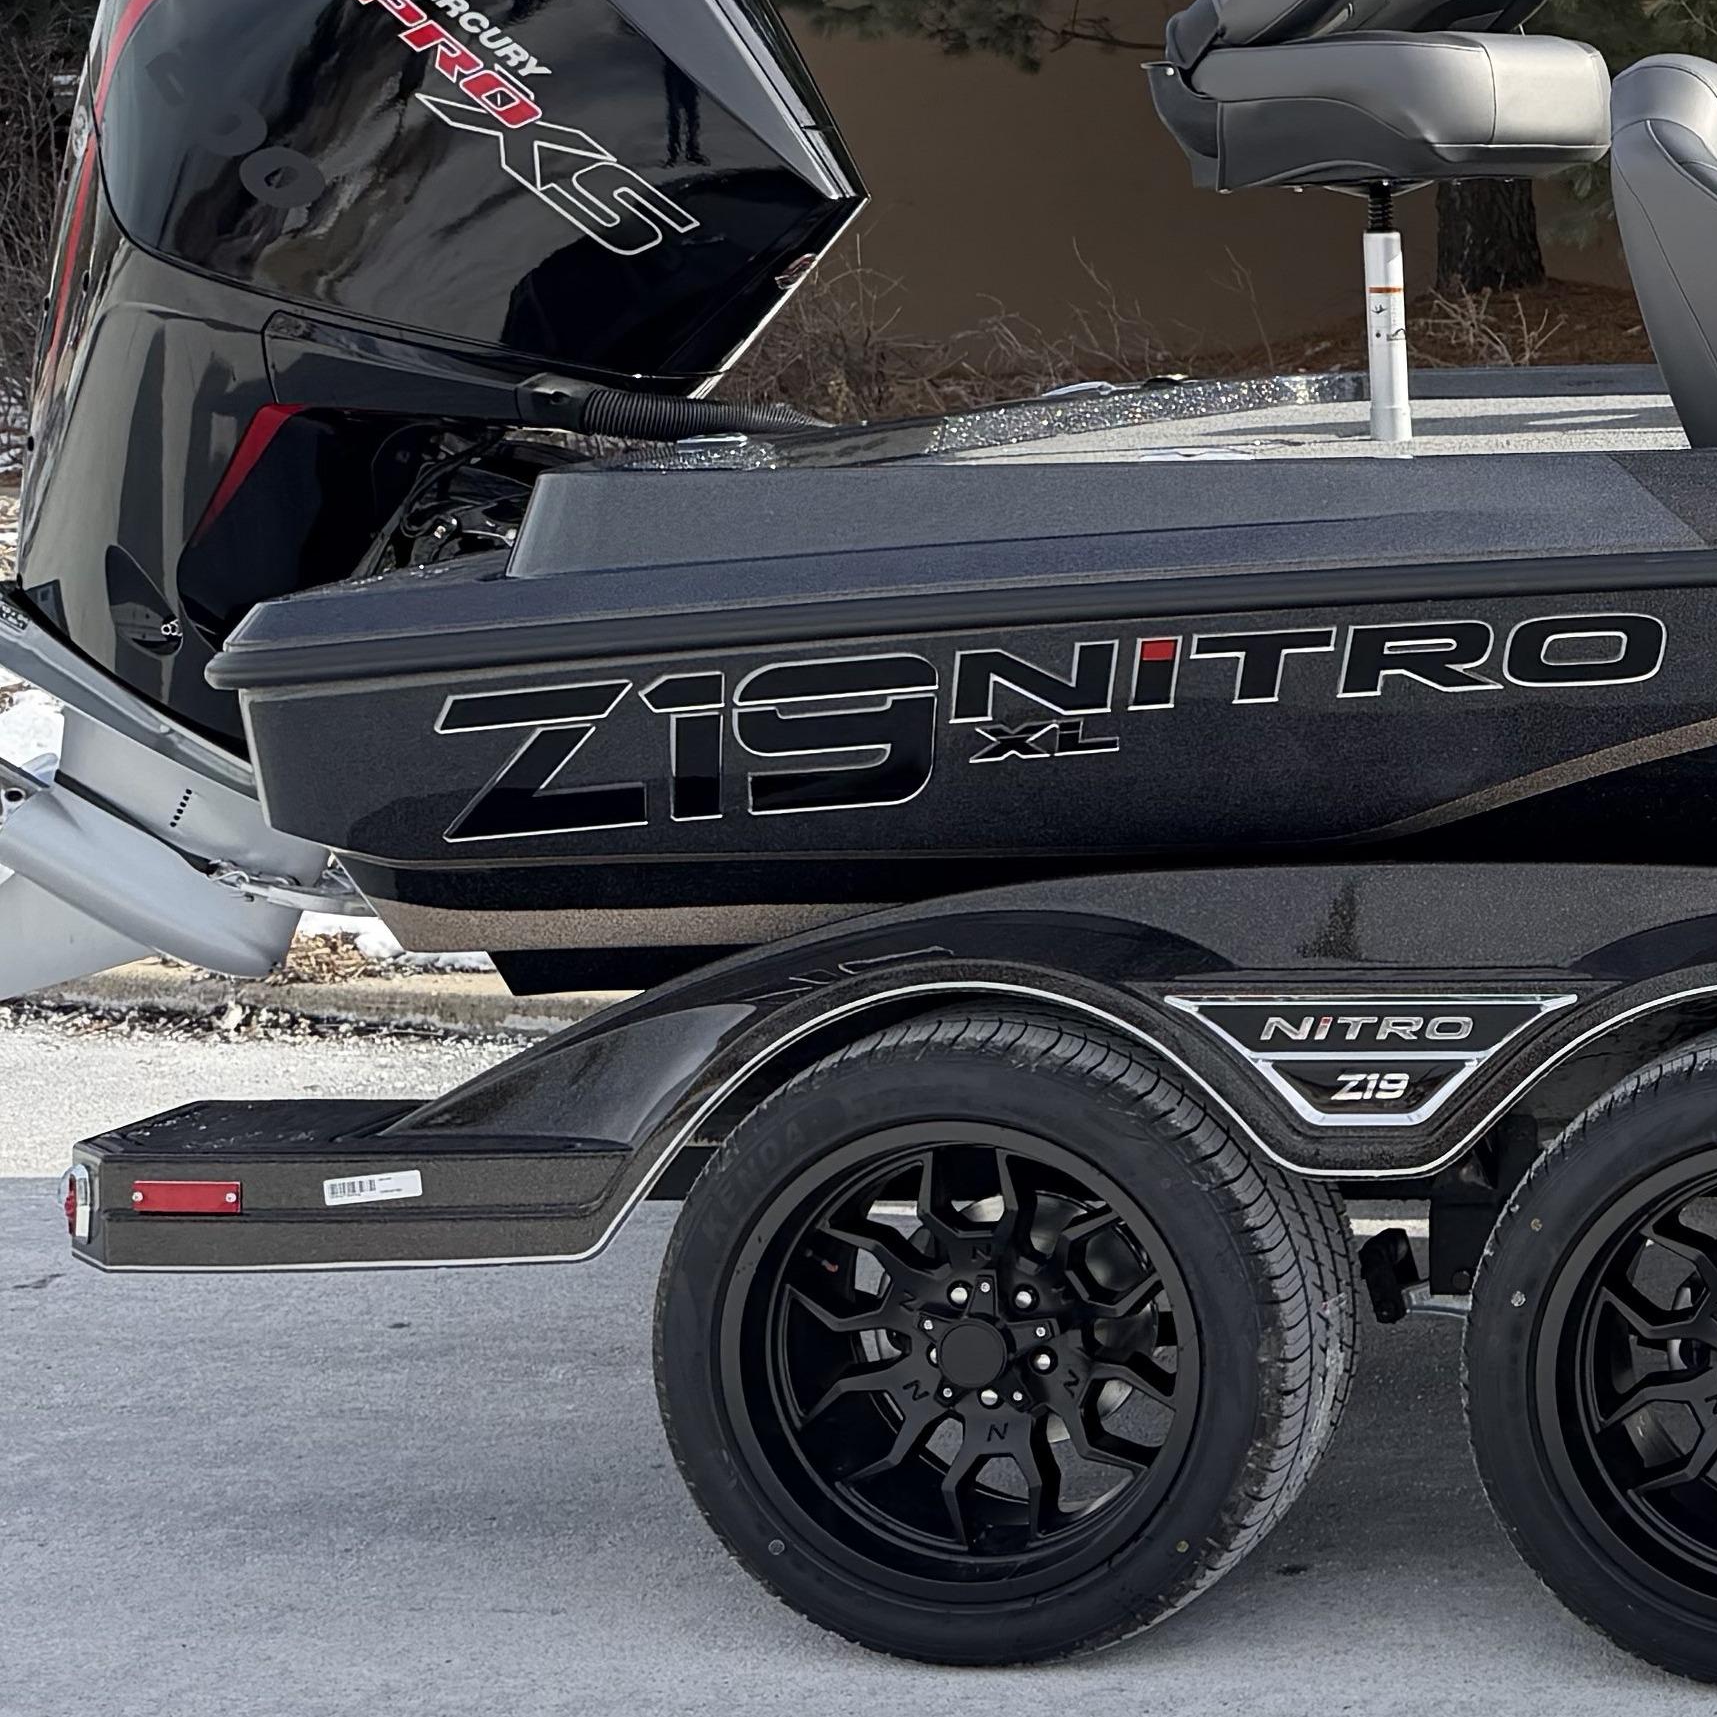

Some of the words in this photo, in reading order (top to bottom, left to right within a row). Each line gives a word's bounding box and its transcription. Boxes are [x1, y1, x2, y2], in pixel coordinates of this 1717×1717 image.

[415, 64, 700, 255] XS
[434, 652, 938, 843] Z19
[949, 613, 1667, 724] NITRO
[969, 719, 1119, 763] XL
[1260, 1016, 1473, 1041] NITRO
[1330, 1073, 1410, 1100] Z19
